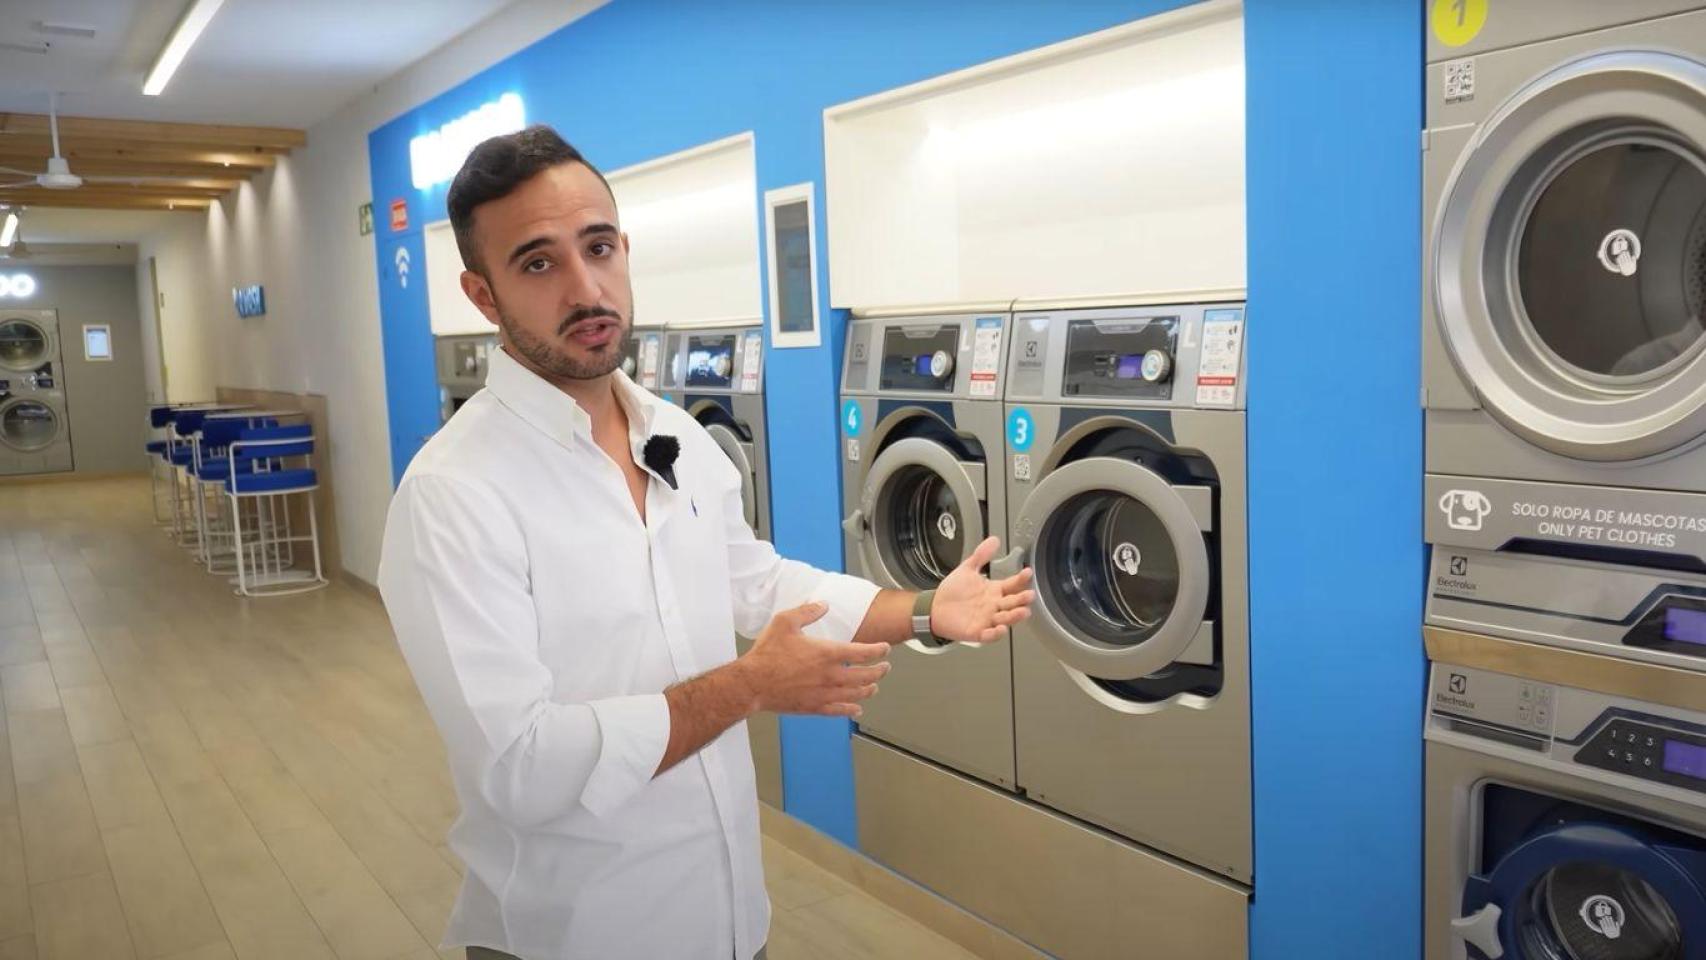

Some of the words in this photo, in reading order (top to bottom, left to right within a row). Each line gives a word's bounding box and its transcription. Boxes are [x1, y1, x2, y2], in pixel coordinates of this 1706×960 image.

[1450, 0, 1467, 27] 1
[1183, 321, 1197, 348] L
[847, 407, 857, 429] 4
[1014, 417, 1028, 445] 3
[1512, 502, 1549, 517] SOLO
[1552, 505, 1591, 521] ROPA
[1595, 509, 1615, 524] DE
[1618, 511, 1706, 532] MASCOTAS
[1538, 521, 1575, 537] ONLY
[1578, 524, 1604, 540] PET
[1607, 528, 1676, 547] CLOTHES
[1437, 576, 1477, 590] Electrolux
[1436, 692, 1476, 709] Electrolux
[1629, 733, 1636, 743] 2
[1644, 757, 1652, 766] 6
